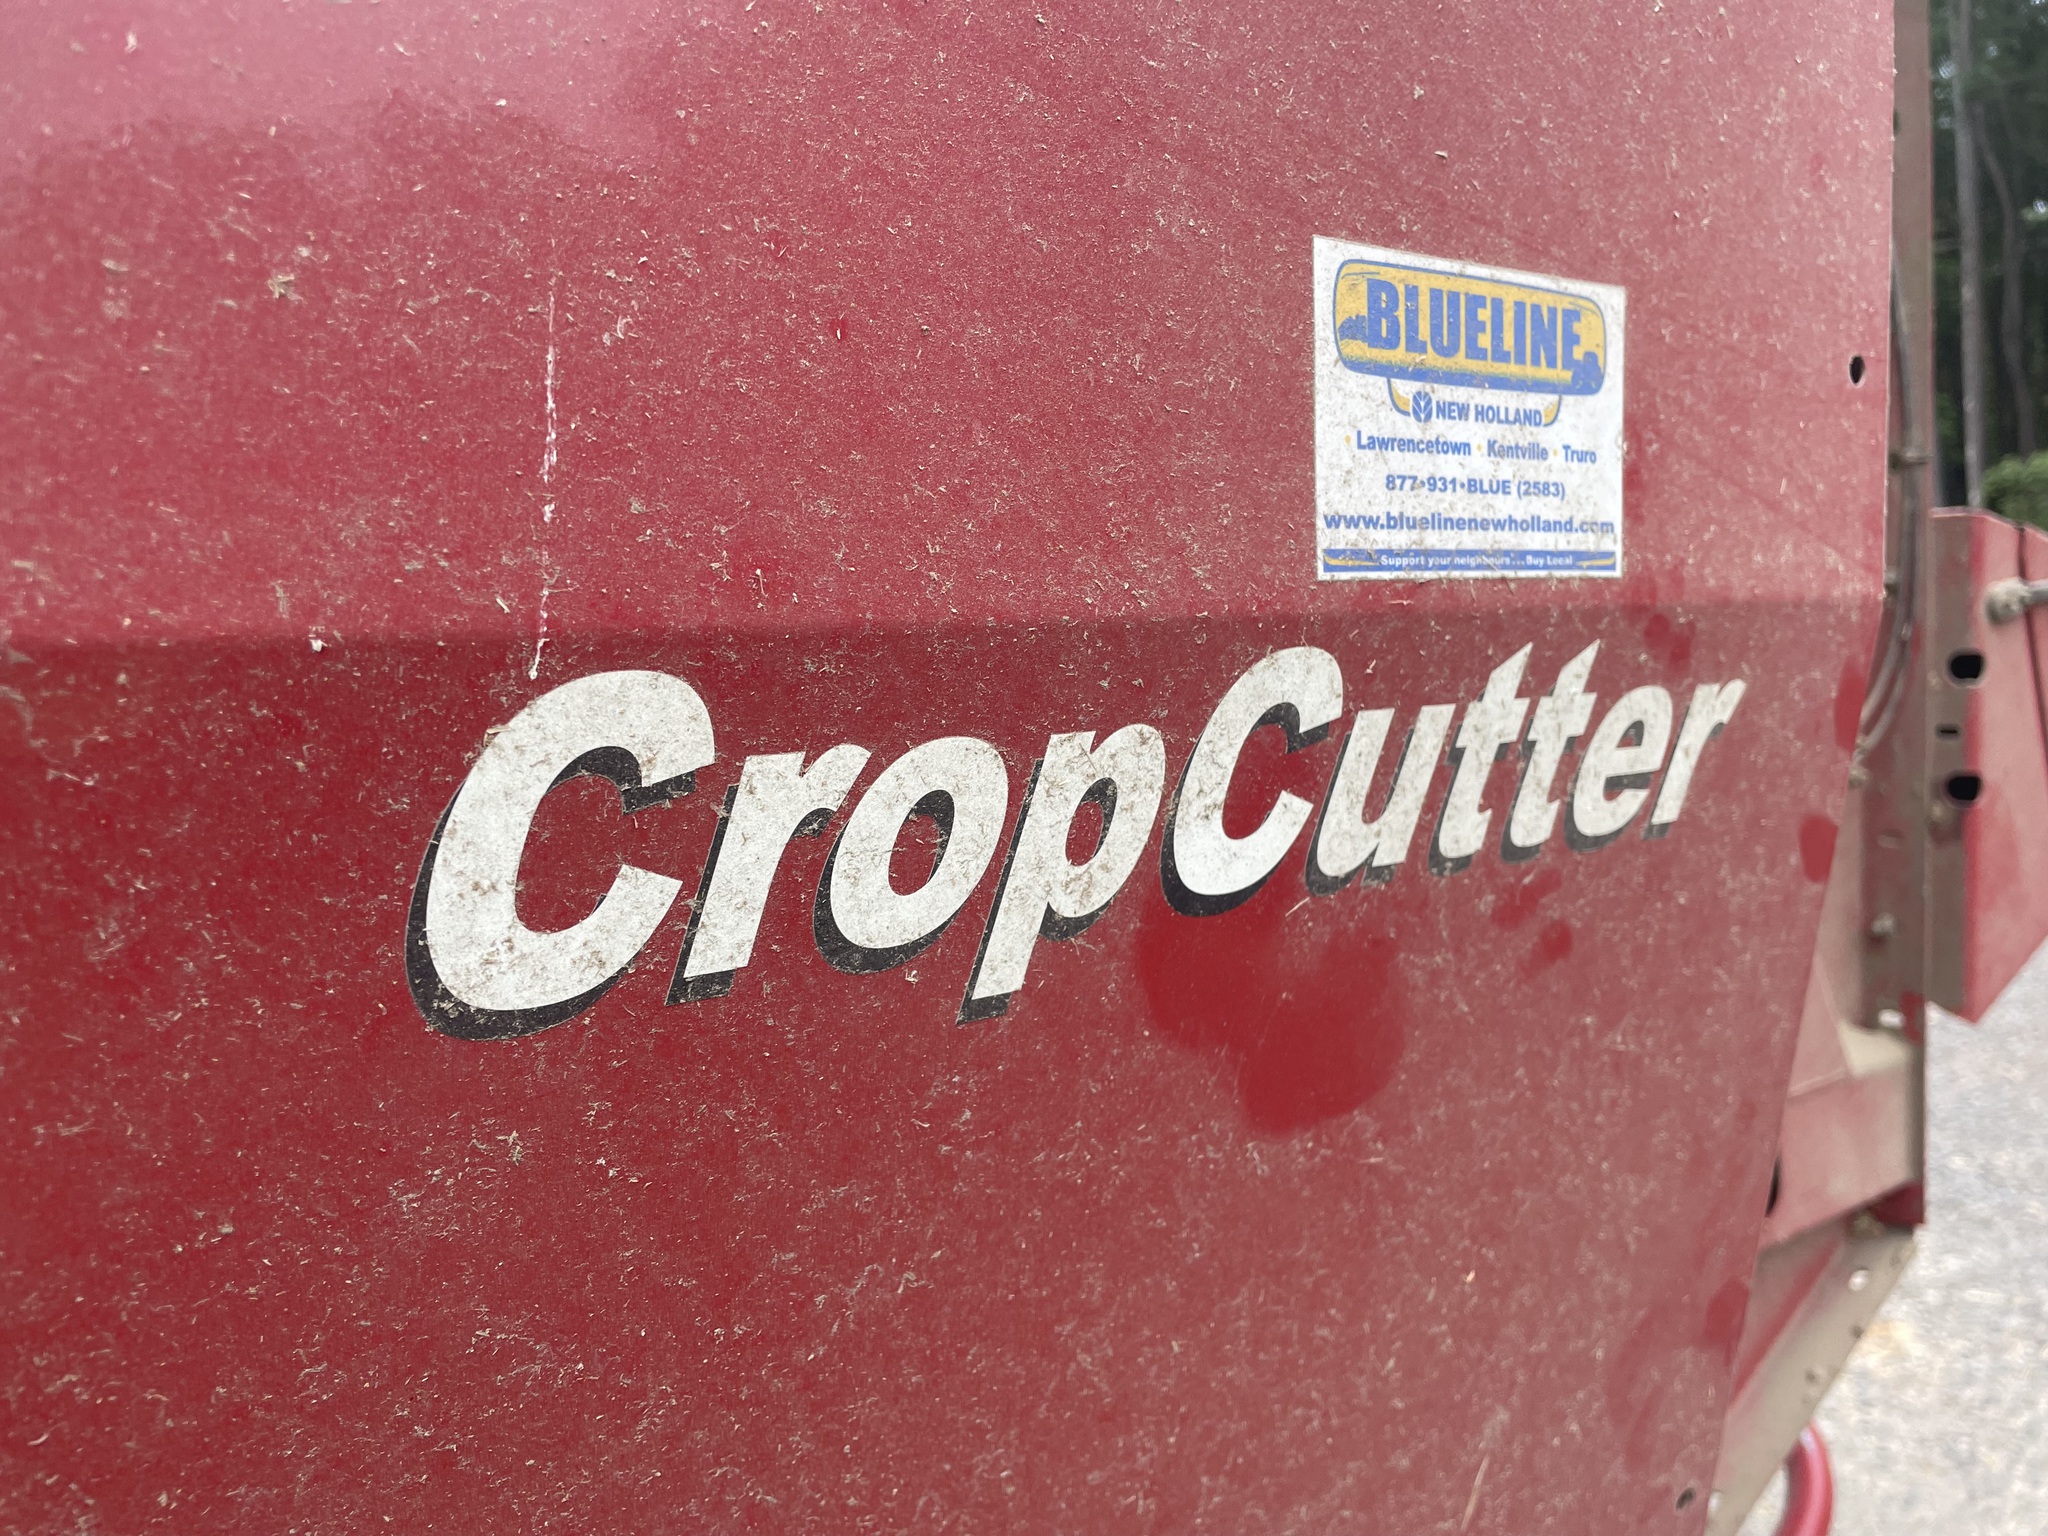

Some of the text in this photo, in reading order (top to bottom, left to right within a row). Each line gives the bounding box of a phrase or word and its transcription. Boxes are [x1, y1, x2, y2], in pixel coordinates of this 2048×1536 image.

[1366, 277, 1582, 370] BLUELINE
[1435, 400, 1543, 427] NEW HOLLAND
[1356, 430, 1598, 464] Lawrencetown Kentville Truro
[1516, 480, 1566, 501] (2583)
[1324, 512, 1615, 533] www.bluelinenewholland.com
[1380, 554, 1425, 567] Support
[404, 640, 1746, 1042] CropCutter
